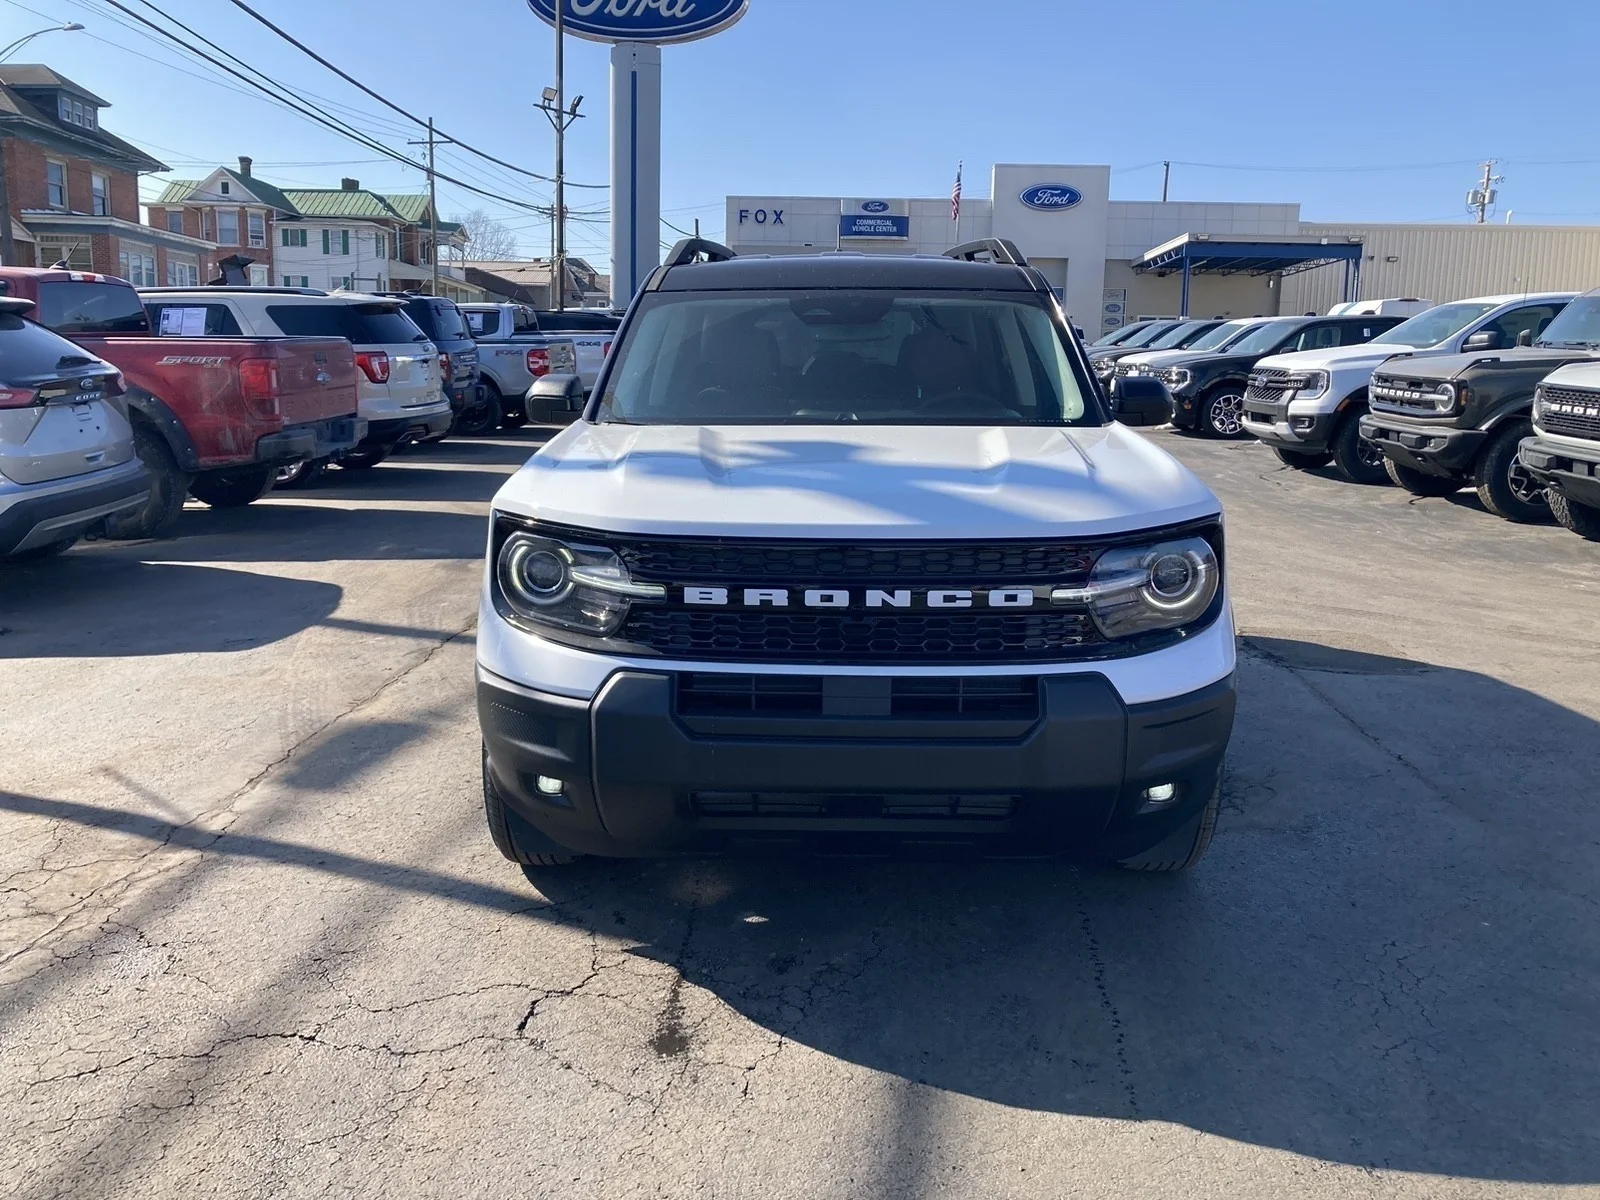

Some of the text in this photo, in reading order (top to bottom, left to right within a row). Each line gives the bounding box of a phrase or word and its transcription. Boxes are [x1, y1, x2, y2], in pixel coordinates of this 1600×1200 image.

[1034, 189, 1070, 205] Ford
[739, 209, 784, 225] FOX
[155, 355, 232, 366] SPORT
[1376, 387, 1421, 399] BRONCO
[684, 587, 1034, 607] BRONCO
